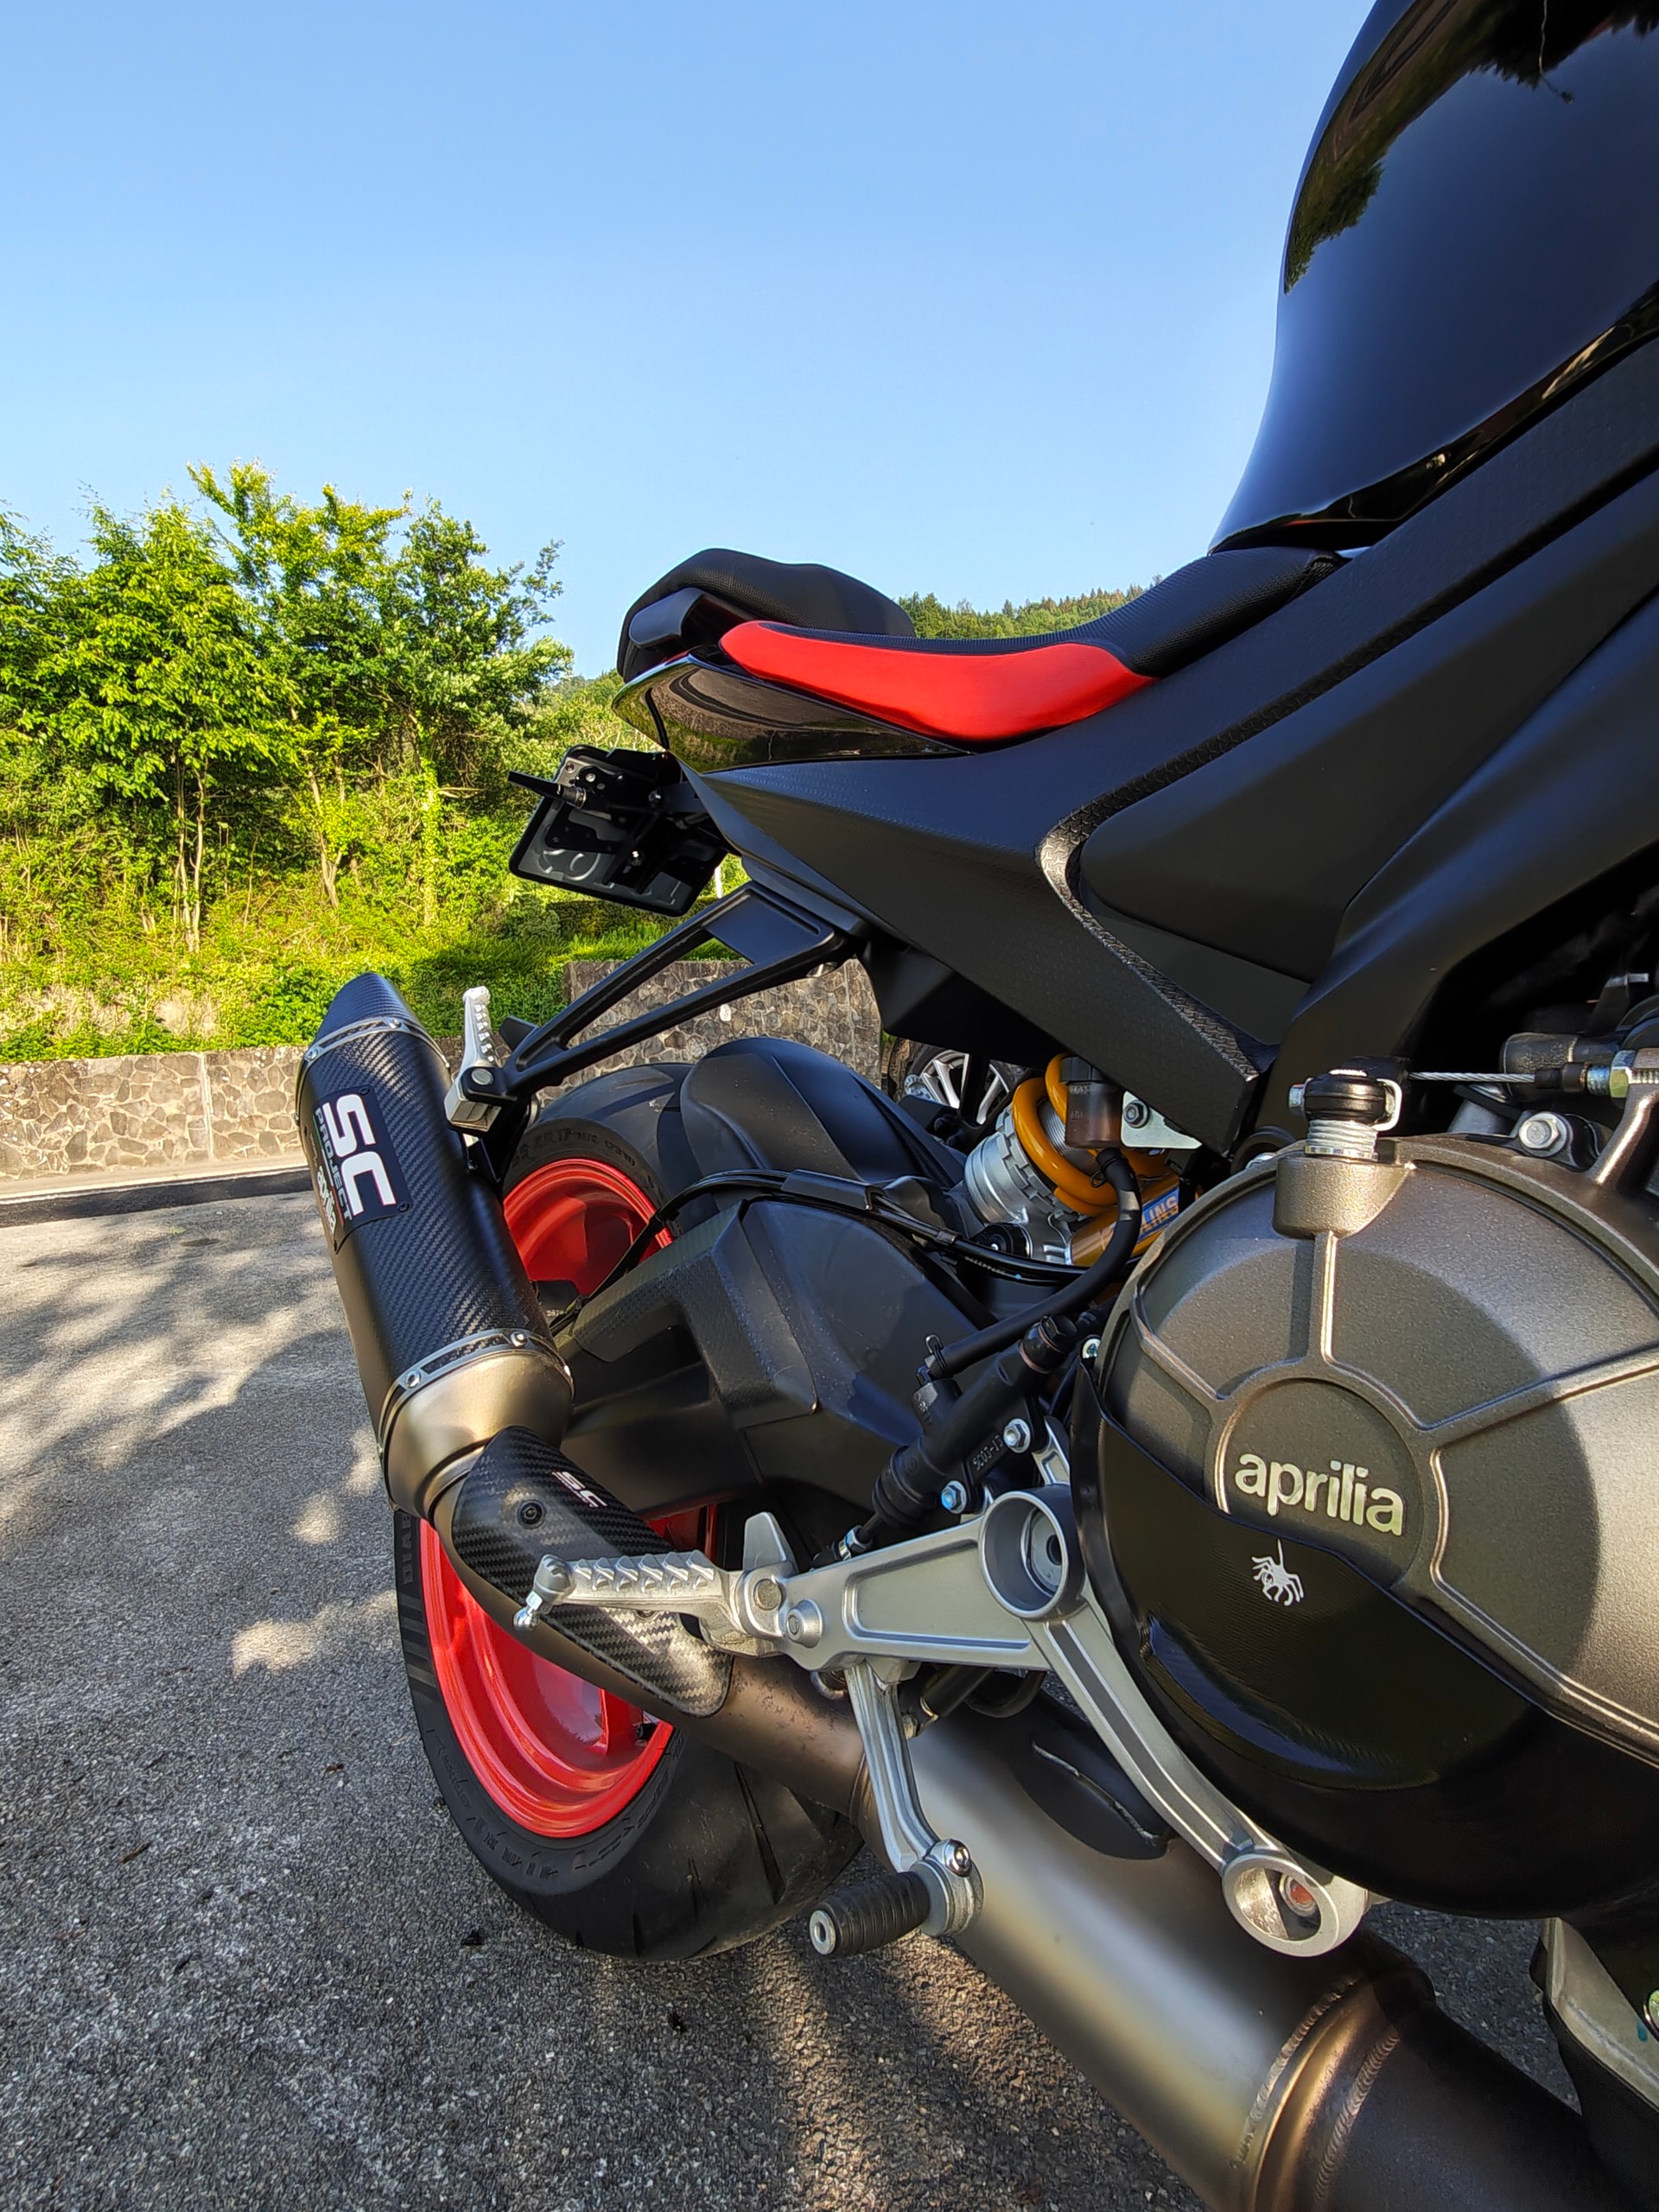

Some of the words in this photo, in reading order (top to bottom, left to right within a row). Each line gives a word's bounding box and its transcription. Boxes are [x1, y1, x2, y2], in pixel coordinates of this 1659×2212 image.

[315, 1107, 353, 1221] PROJECT
[322, 1094, 397, 1217] SC
[1235, 1453, 1404, 1536] aprilia
